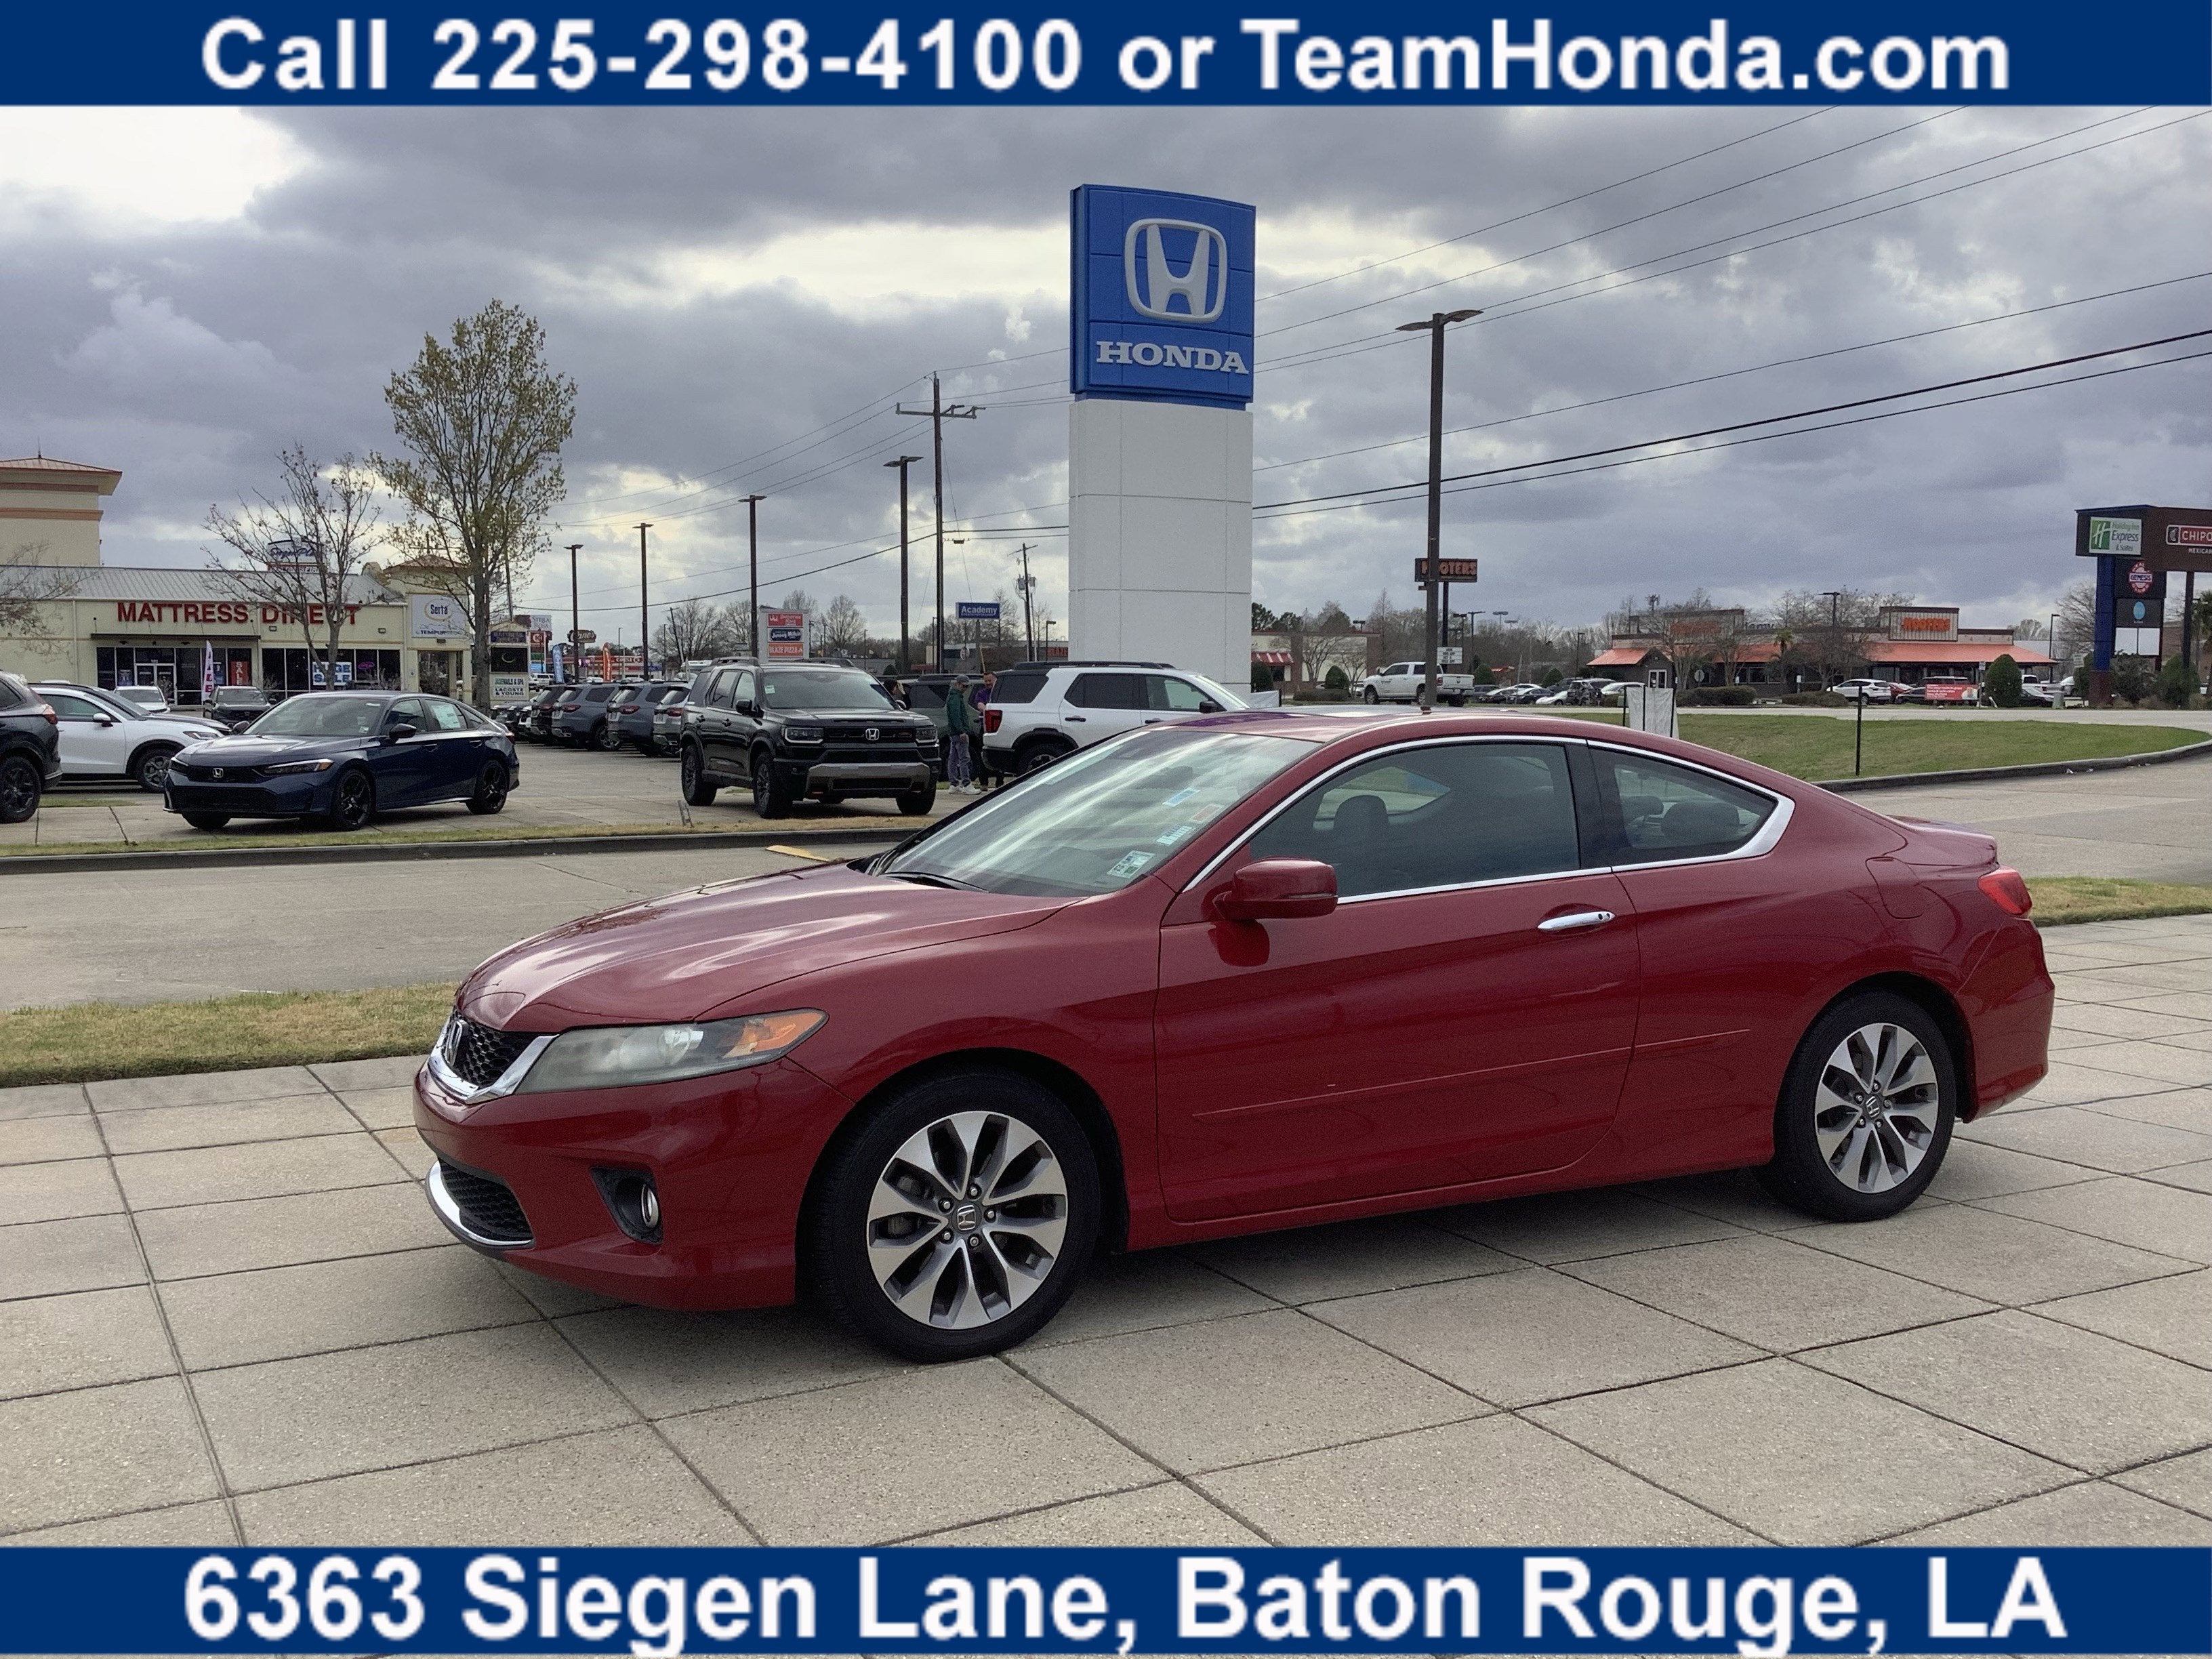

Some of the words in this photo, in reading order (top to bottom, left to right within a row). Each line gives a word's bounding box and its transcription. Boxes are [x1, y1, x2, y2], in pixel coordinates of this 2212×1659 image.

[1096, 341, 1249, 374] HONDA
[2112, 529, 2139, 542] Express
[1421, 560, 1477, 575] OTERS
[117, 602, 249, 623] MATTRESS
[262, 603, 361, 625] DIET
[430, 604, 448, 615] Serta
[961, 605, 998, 616] Academy
[314, 664, 350, 673] HGE
[314, 674, 350, 682] SLE
